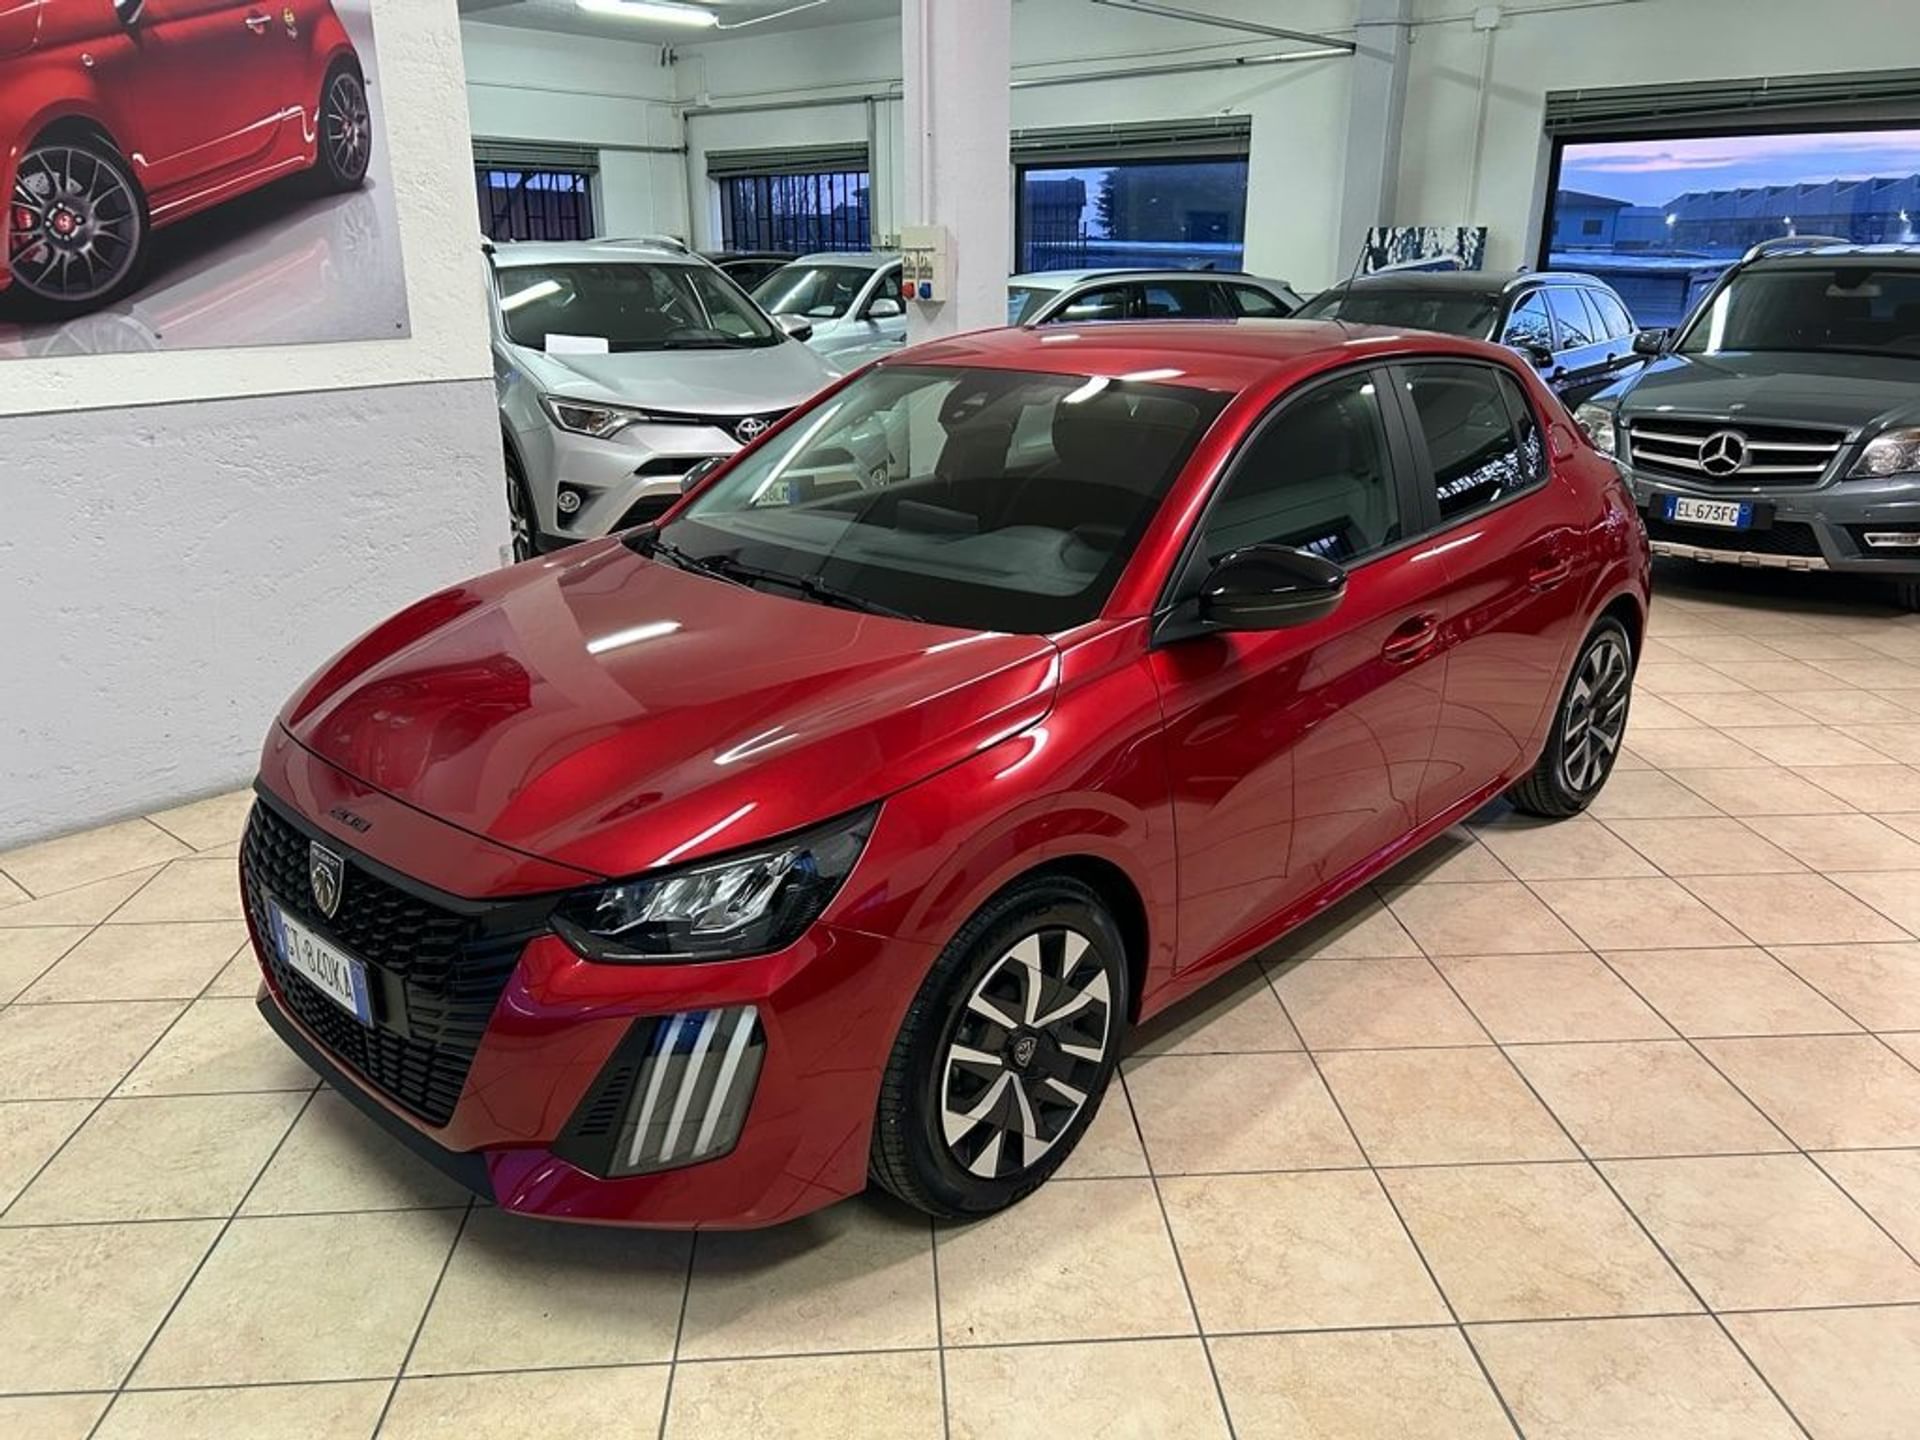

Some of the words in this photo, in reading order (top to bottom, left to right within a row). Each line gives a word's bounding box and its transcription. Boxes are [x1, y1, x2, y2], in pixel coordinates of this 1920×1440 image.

[1678, 501, 1693, 517] EL
[1696, 504, 1738, 522] 673FC
[305, 938, 355, 1001] 840KA
